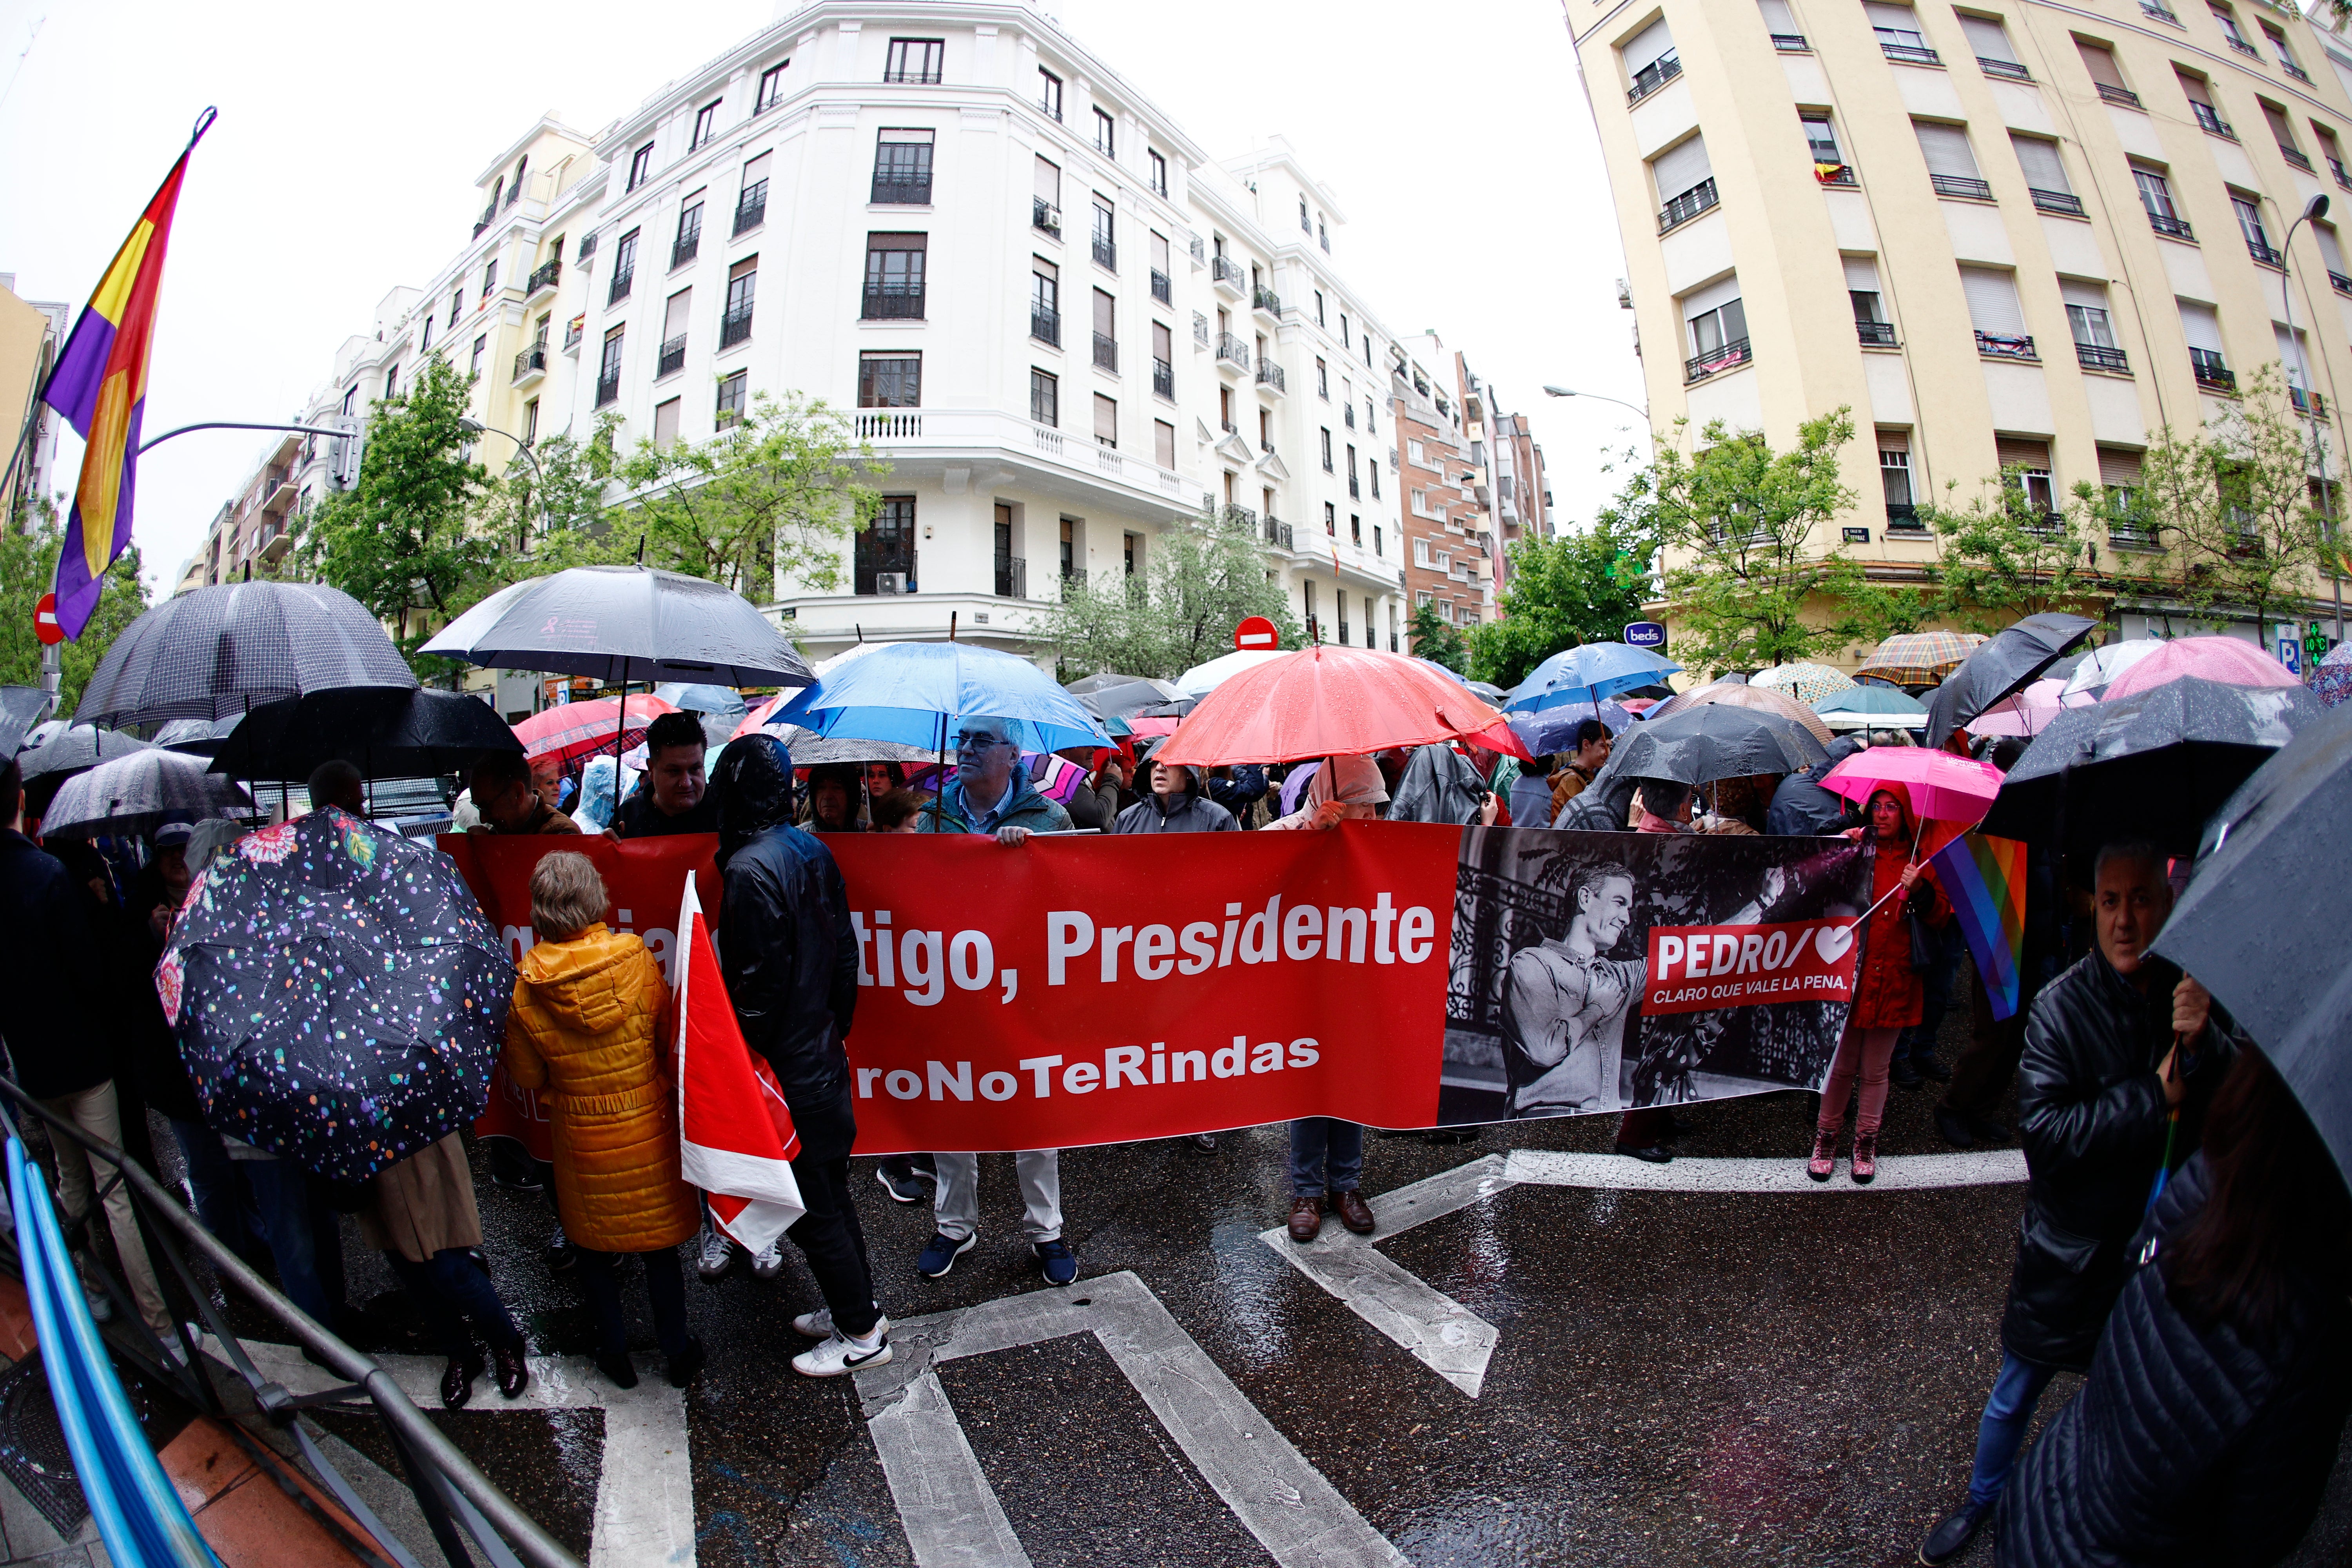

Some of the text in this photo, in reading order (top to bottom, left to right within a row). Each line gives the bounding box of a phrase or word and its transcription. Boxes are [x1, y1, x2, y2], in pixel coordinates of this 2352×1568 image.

[1630, 628, 1659, 641] bed's
[2281, 642, 2295, 668] P
[1047, 892, 1435, 986] Presidente
[1653, 975, 1847, 1004] CLARO QUE VALE LA PENA.
